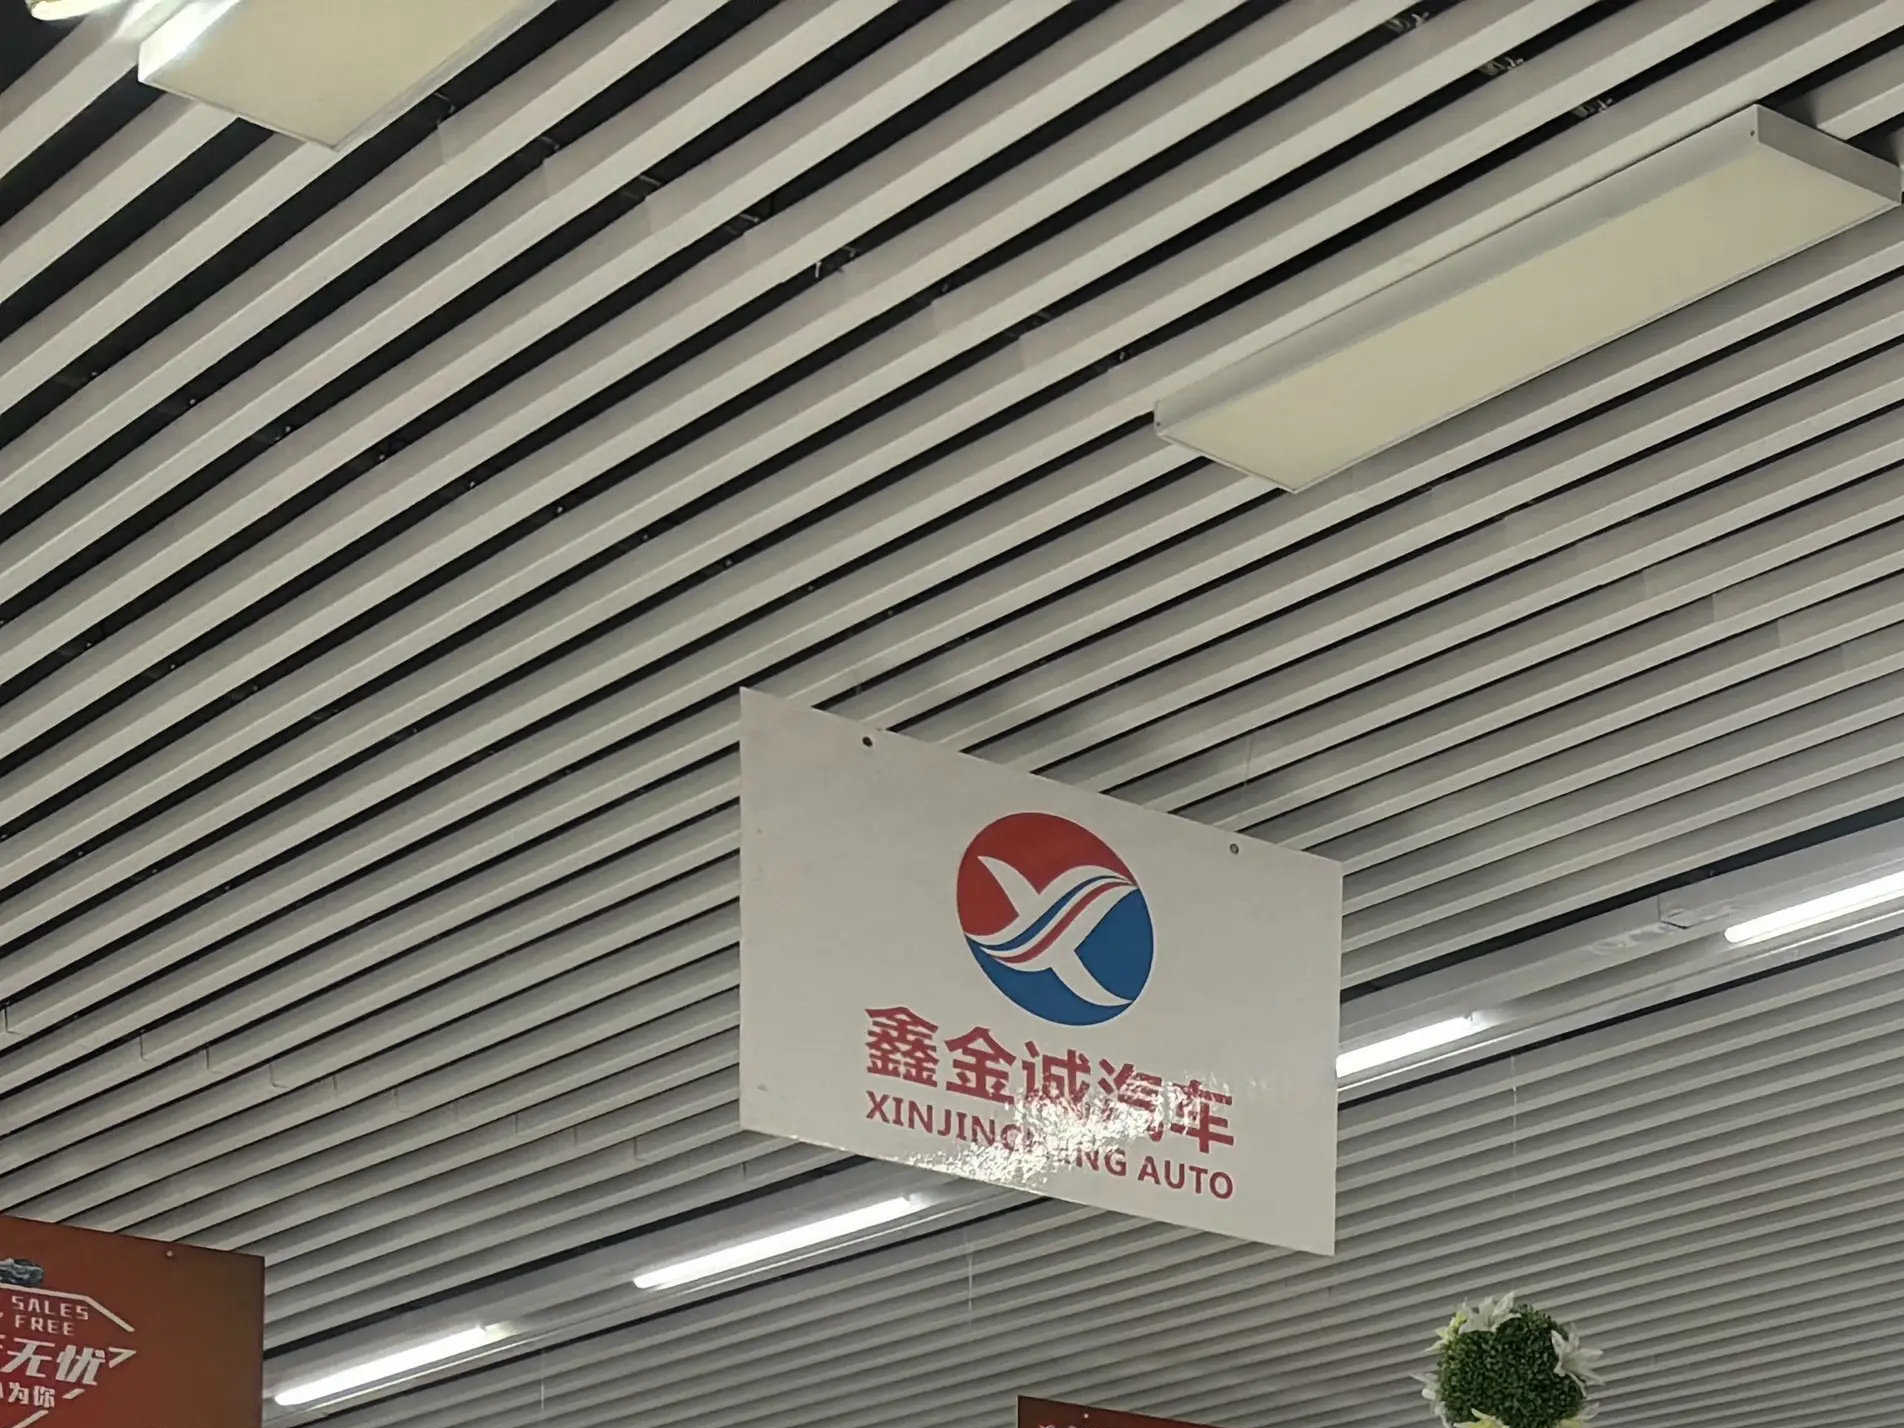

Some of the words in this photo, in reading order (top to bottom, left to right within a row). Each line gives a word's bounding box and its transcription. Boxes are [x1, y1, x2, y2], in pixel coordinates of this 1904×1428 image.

[865, 1005, 1235, 1154] 鑫金诚汽车
[865, 1090, 1127, 1177] XINJINCNG
[1137, 1155, 1234, 1200] AUTO
[11, 1295, 90, 1321] SALES
[15, 1313, 76, 1337] FREE
[0, 1333, 106, 1386] 无忧
